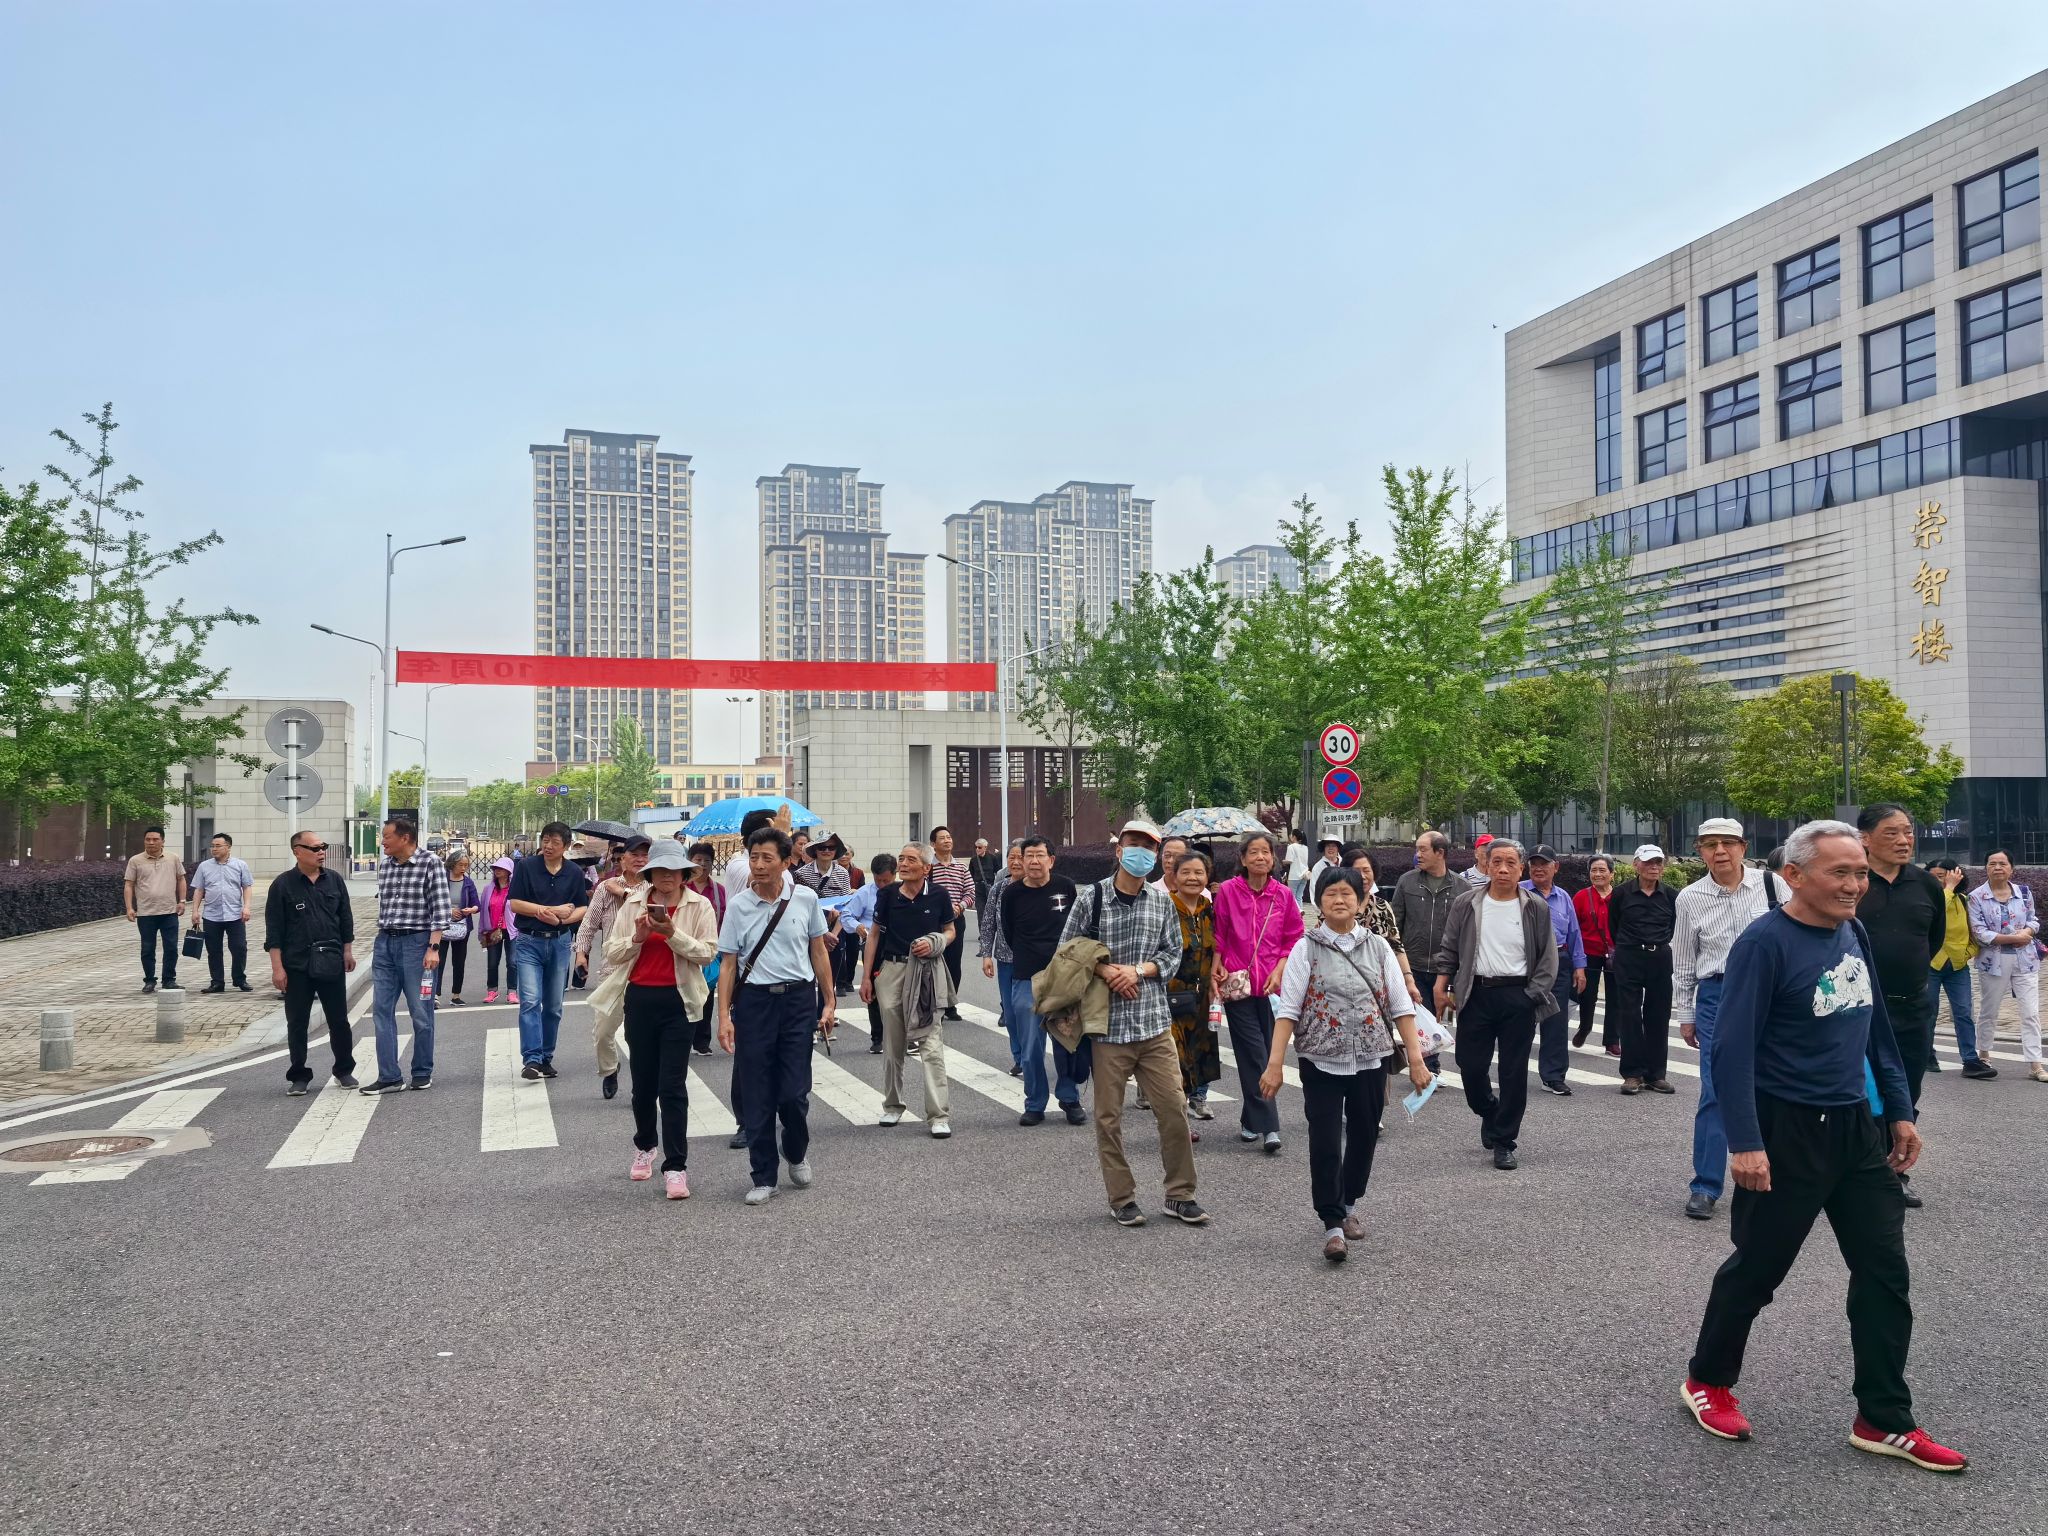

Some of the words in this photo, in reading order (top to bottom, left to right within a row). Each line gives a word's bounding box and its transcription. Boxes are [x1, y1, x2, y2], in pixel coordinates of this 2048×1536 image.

[1909, 500, 1953, 666] 崇智楼
[1328, 735, 1351, 754] 30
[1324, 814, 1359, 822] 全路段禁停
